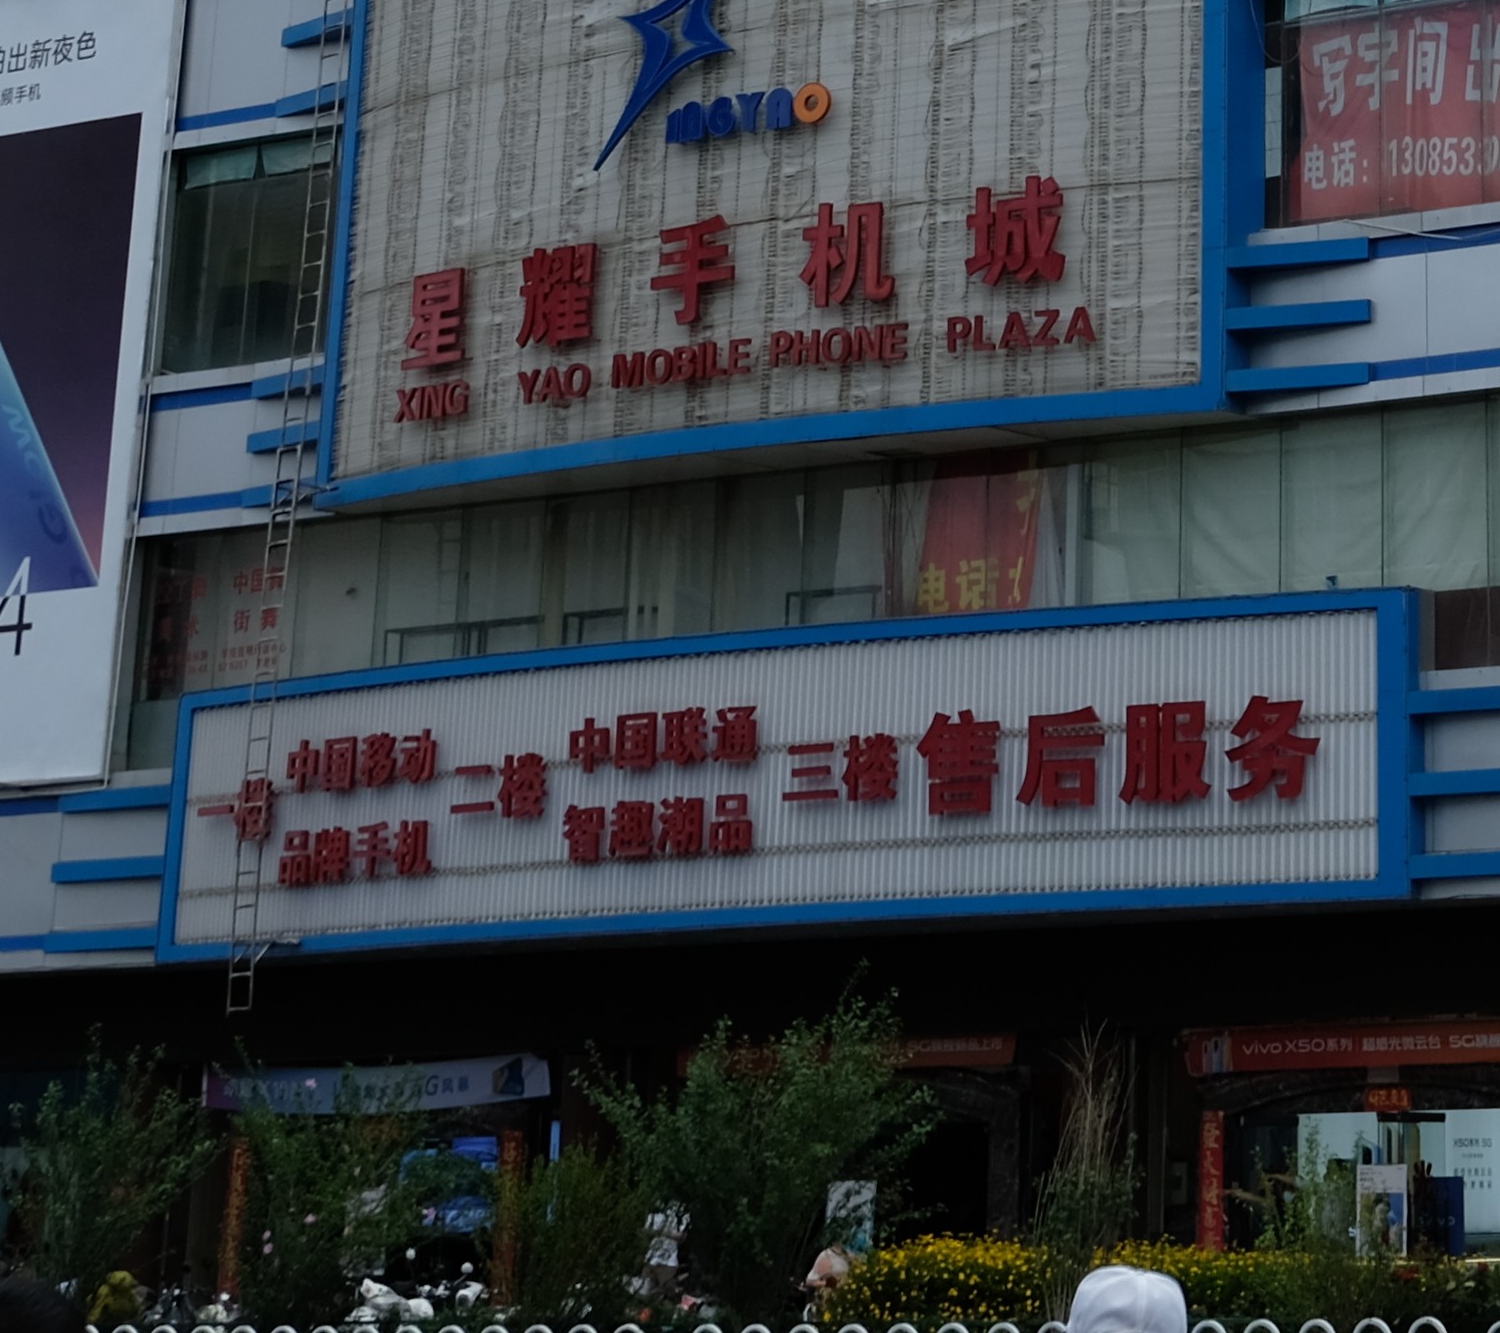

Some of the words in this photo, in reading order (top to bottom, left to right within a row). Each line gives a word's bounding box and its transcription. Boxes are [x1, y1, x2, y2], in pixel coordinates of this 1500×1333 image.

[401, 174, 1068, 370] 星耀手机城
[393, 380, 469, 424] XING
[517, 362, 592, 406] YAO
[611, 337, 753, 391] MOBILE
[767, 321, 910, 369] PHONE
[946, 306, 1098, 353] PLAZA
[286, 729, 437, 793] 中国移动
[569, 705, 759, 774] 中国联通
[782, 732, 900, 803] 三楼
[916, 694, 1321, 816] 售后服务
[197, 776, 279, 844] 一楼
[450, 751, 550, 820] 二楼
[277, 819, 433, 887] 品牌手机
[562, 792, 754, 865] 智趣潮品
[1242, 1040, 1283, 1056] vivo
